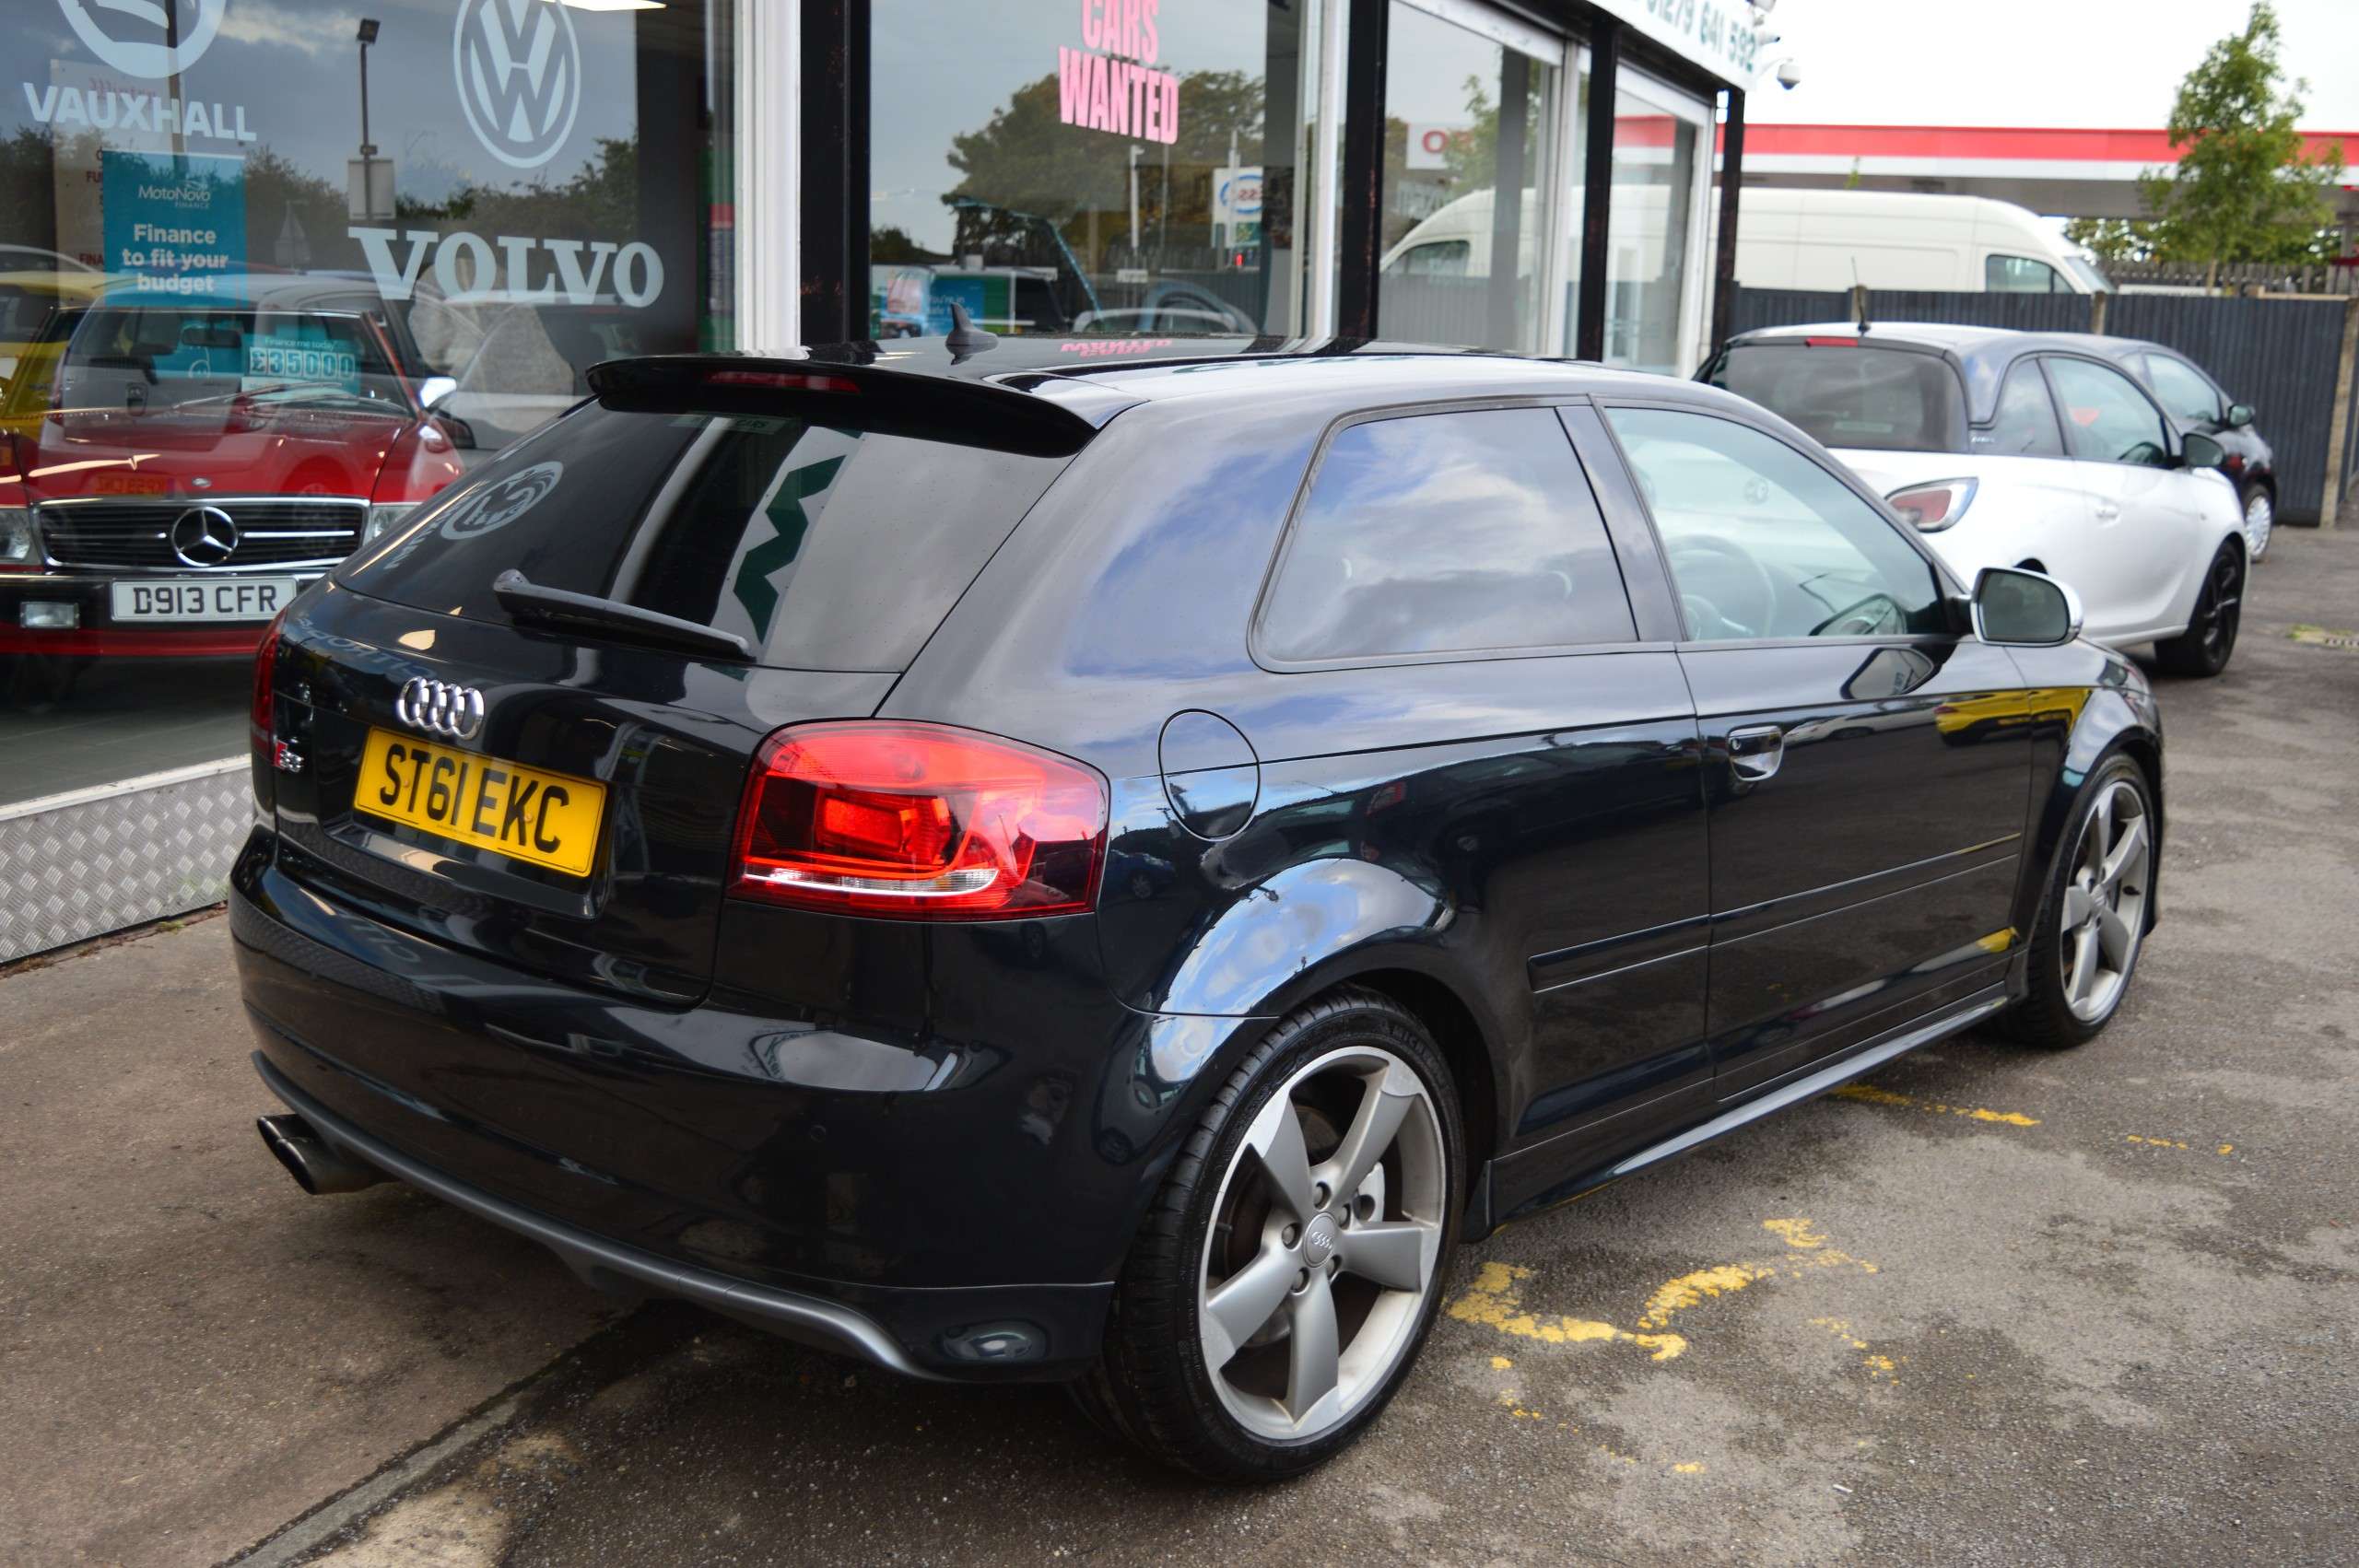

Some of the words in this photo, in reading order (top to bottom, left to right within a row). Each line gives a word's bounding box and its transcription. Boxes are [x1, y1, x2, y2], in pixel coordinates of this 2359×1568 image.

[1082, 0, 1158, 64] CARS
[23, 82, 257, 142] VAUXHALL
[1059, 45, 1180, 145] WANTED
[138, 184, 211, 202] MotoNovo
[134, 224, 217, 244] Finance
[122, 249, 144, 265] to
[151, 249, 175, 266] fit
[179, 253, 229, 270] your
[349, 227, 664, 308] VOLVO
[137, 274, 216, 295] budget
[134, 587, 205, 614] D913
[216, 584, 276, 613] CFR
[380, 743, 469, 826] ST61
[472, 767, 569, 854] EKC
